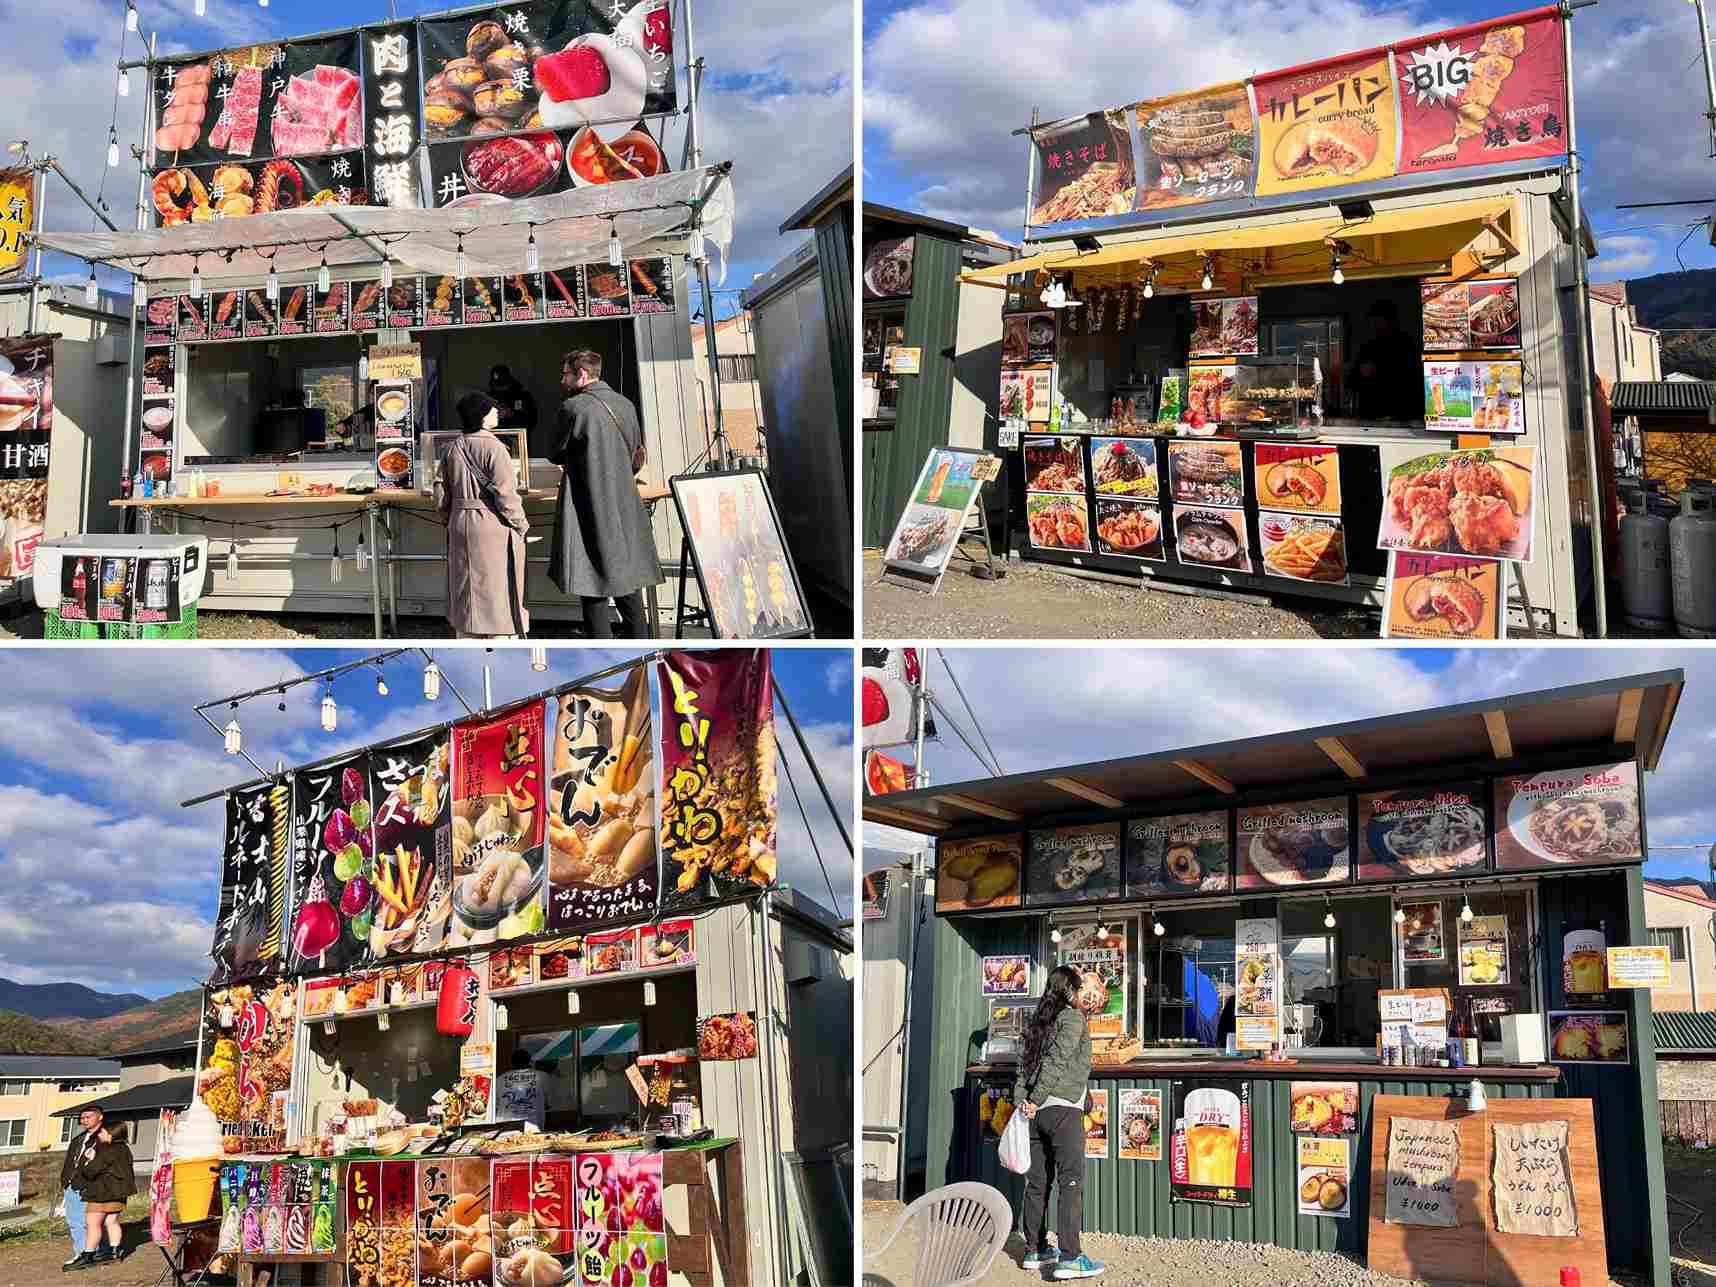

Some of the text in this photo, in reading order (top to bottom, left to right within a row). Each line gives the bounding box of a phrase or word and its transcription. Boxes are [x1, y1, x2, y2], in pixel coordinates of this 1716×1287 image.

[504, 10, 532, 91] 焼き栗
[1412, 55, 1471, 91] BIG
[1266, 75, 1390, 122] カレーパン
[371, 33, 412, 204] 肉と海鮮
[1318, 110, 1345, 125] curry
[1484, 112, 1562, 147] 焼き鳥
[1047, 143, 1107, 169] 焼きそば
[1194, 181, 1246, 198] フランク
[24, 348, 47, 431] チャイ
[4, 442, 49, 469] 甘酒
[561, 697, 619, 829] おでん
[671, 670, 724, 847] とりかわ
[1511, 770, 1625, 794] Tempura Soba
[1244, 814, 1284, 832] Grilled
[1199, 1111, 1225, 1122] DRY
[1514, 1156, 1559, 1177] 天ぷら
[422, 1165, 456, 1245] おでん
[582, 1160, 603, 1278] フルーツ飴
[1514, 1201, 1563, 1218] ¥1000
